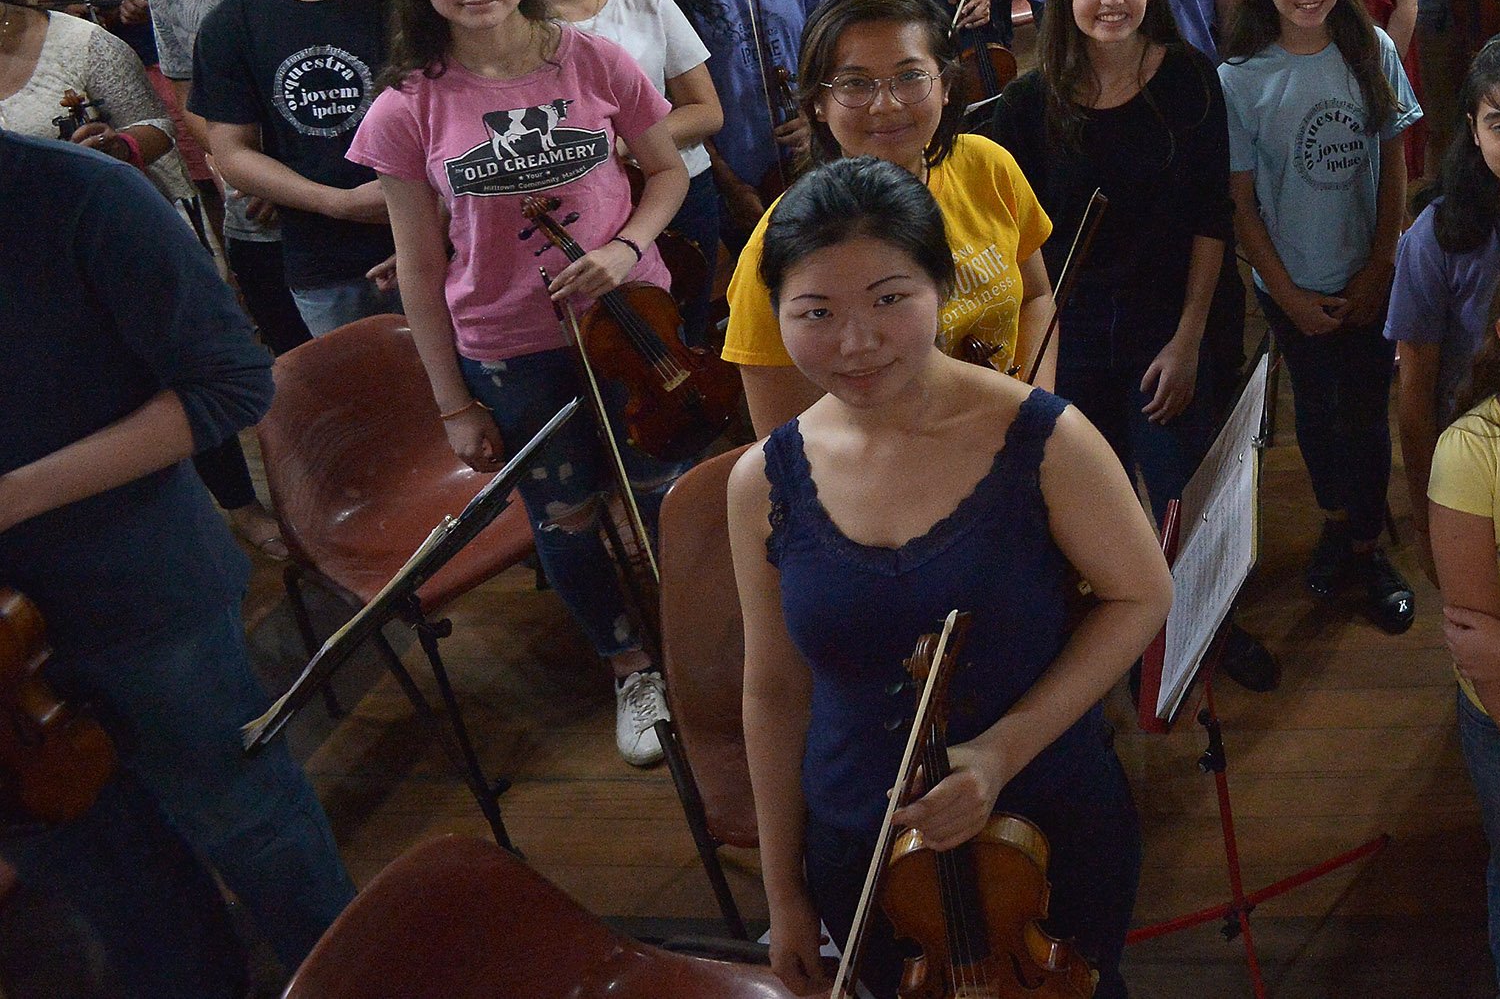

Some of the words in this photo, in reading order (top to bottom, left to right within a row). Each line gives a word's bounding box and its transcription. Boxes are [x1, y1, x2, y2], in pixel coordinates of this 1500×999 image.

[284, 56, 355, 111] orquestra
[299, 87, 360, 107] jovem
[312, 102, 356, 119] ipdae
[1304, 110, 1360, 170] orquestra
[1316, 139, 1364, 163] jovem
[464, 162, 499, 181] OLD
[503, 143, 597, 172] CREAMERY
[525, 171, 544, 180] Your
[1326, 156, 1361, 172] ipdae
[483, 183, 516, 192] Hilltown
[518, 176, 560, 190] Community
[562, 165, 587, 179] Market
[954, 244, 1009, 298] UISITE
[942, 276, 1017, 324] orthiness.
